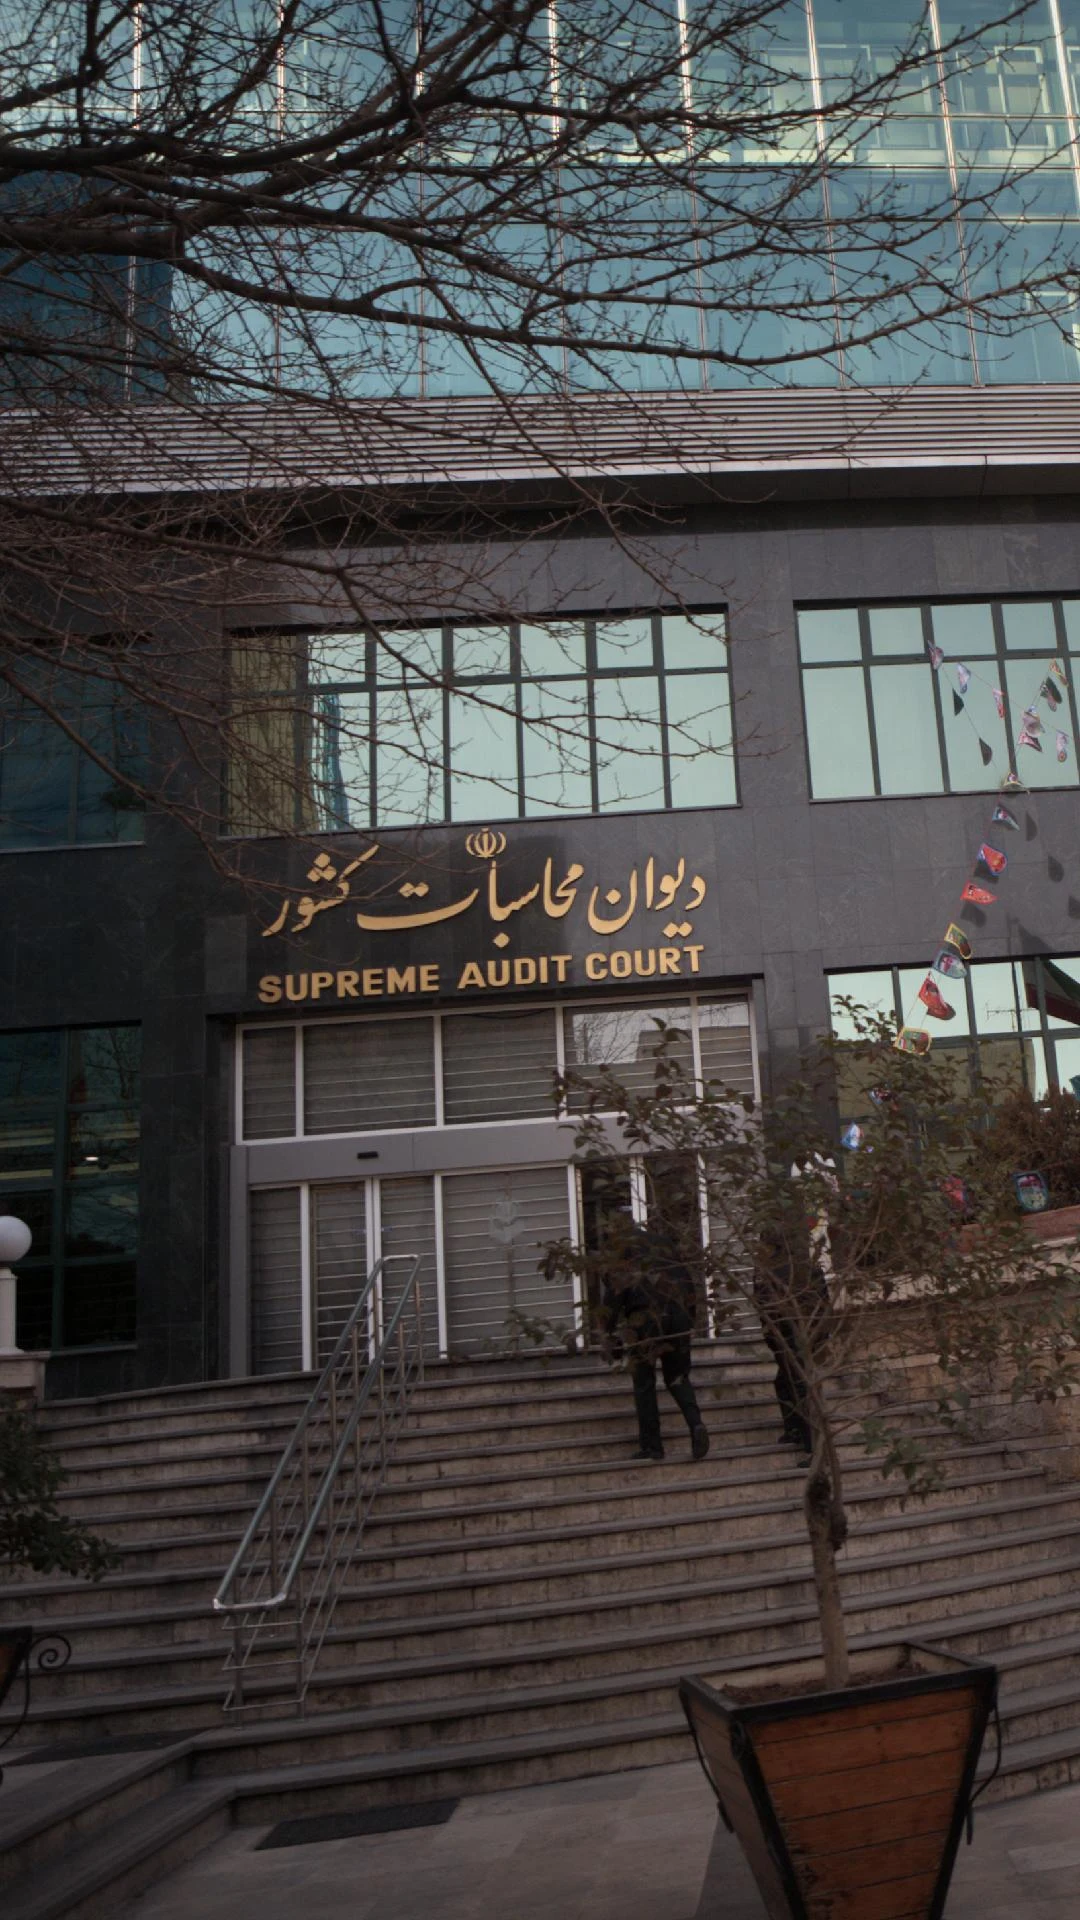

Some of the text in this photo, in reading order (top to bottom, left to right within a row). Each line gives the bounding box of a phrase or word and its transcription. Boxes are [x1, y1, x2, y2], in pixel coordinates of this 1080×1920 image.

[261, 844, 708, 948] دیوان محاسبات کشور
[258, 944, 706, 1004] SUPREME AUDIT COURT
